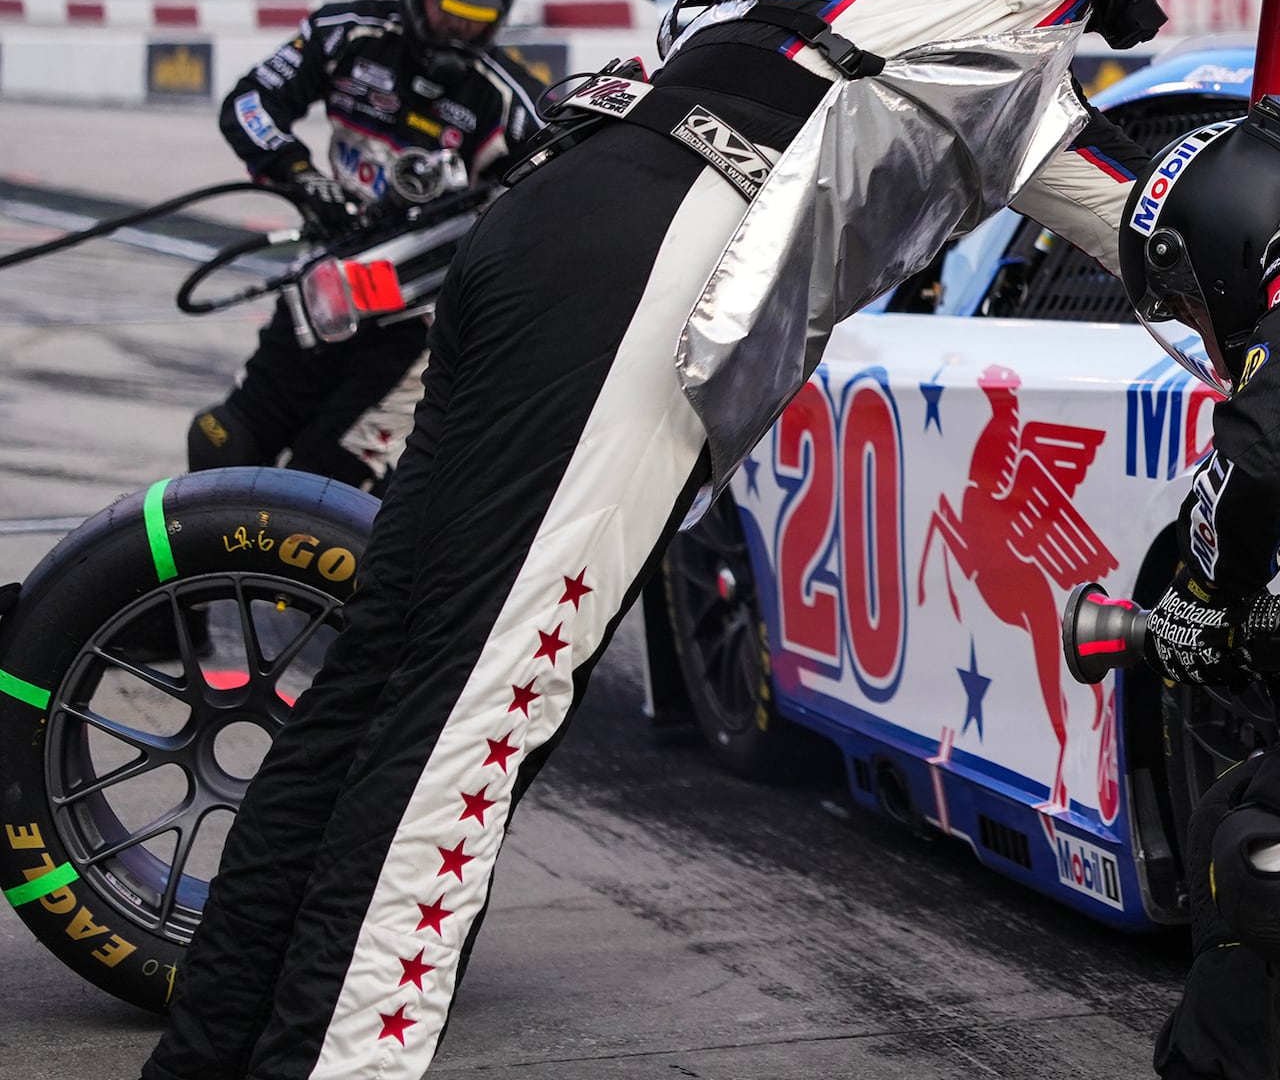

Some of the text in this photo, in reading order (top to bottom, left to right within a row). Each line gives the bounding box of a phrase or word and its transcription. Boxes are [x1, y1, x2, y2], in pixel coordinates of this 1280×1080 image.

[675, 125, 759, 197] MECHANIX WEAR
[1133, 142, 1198, 231] Mobil
[776, 375, 906, 691] 20
[1159, 586, 1228, 629] Mechanix
[5, 823, 138, 969] EAGLE
[1056, 836, 1103, 895] Mobil
